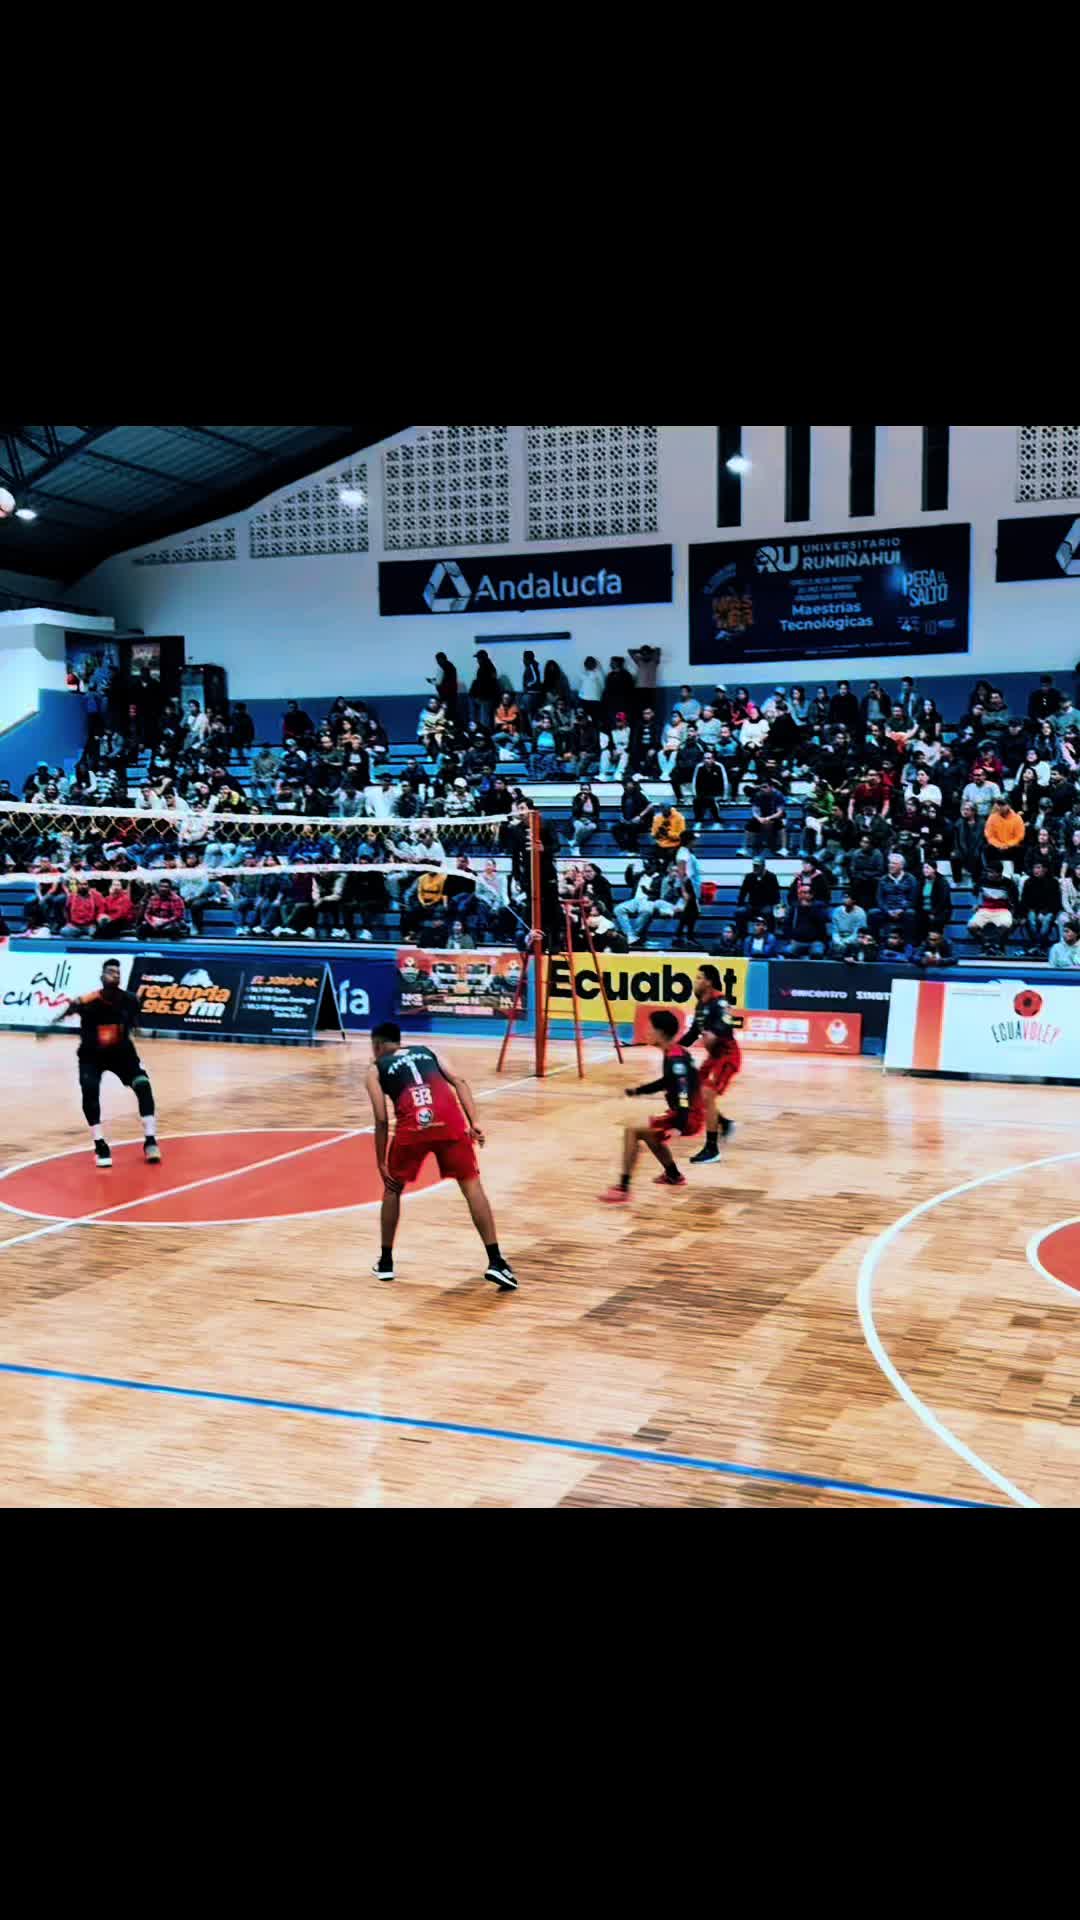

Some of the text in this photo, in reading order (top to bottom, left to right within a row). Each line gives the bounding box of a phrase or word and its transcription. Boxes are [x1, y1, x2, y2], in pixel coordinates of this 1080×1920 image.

[802, 537, 901, 553] UNIVERSITARIO
[802, 551, 901, 571] RUMIÑAHUI
[475, 568, 622, 602] Andalucía
[909, 582, 949, 607] SALTO
[792, 601, 862, 617] Maestrías
[781, 615, 874, 633] Tecnológicas
[550, 959, 737, 1006] Ecuabt
[136, 983, 231, 1003] redonda
[189, 998, 226, 1017] fm
